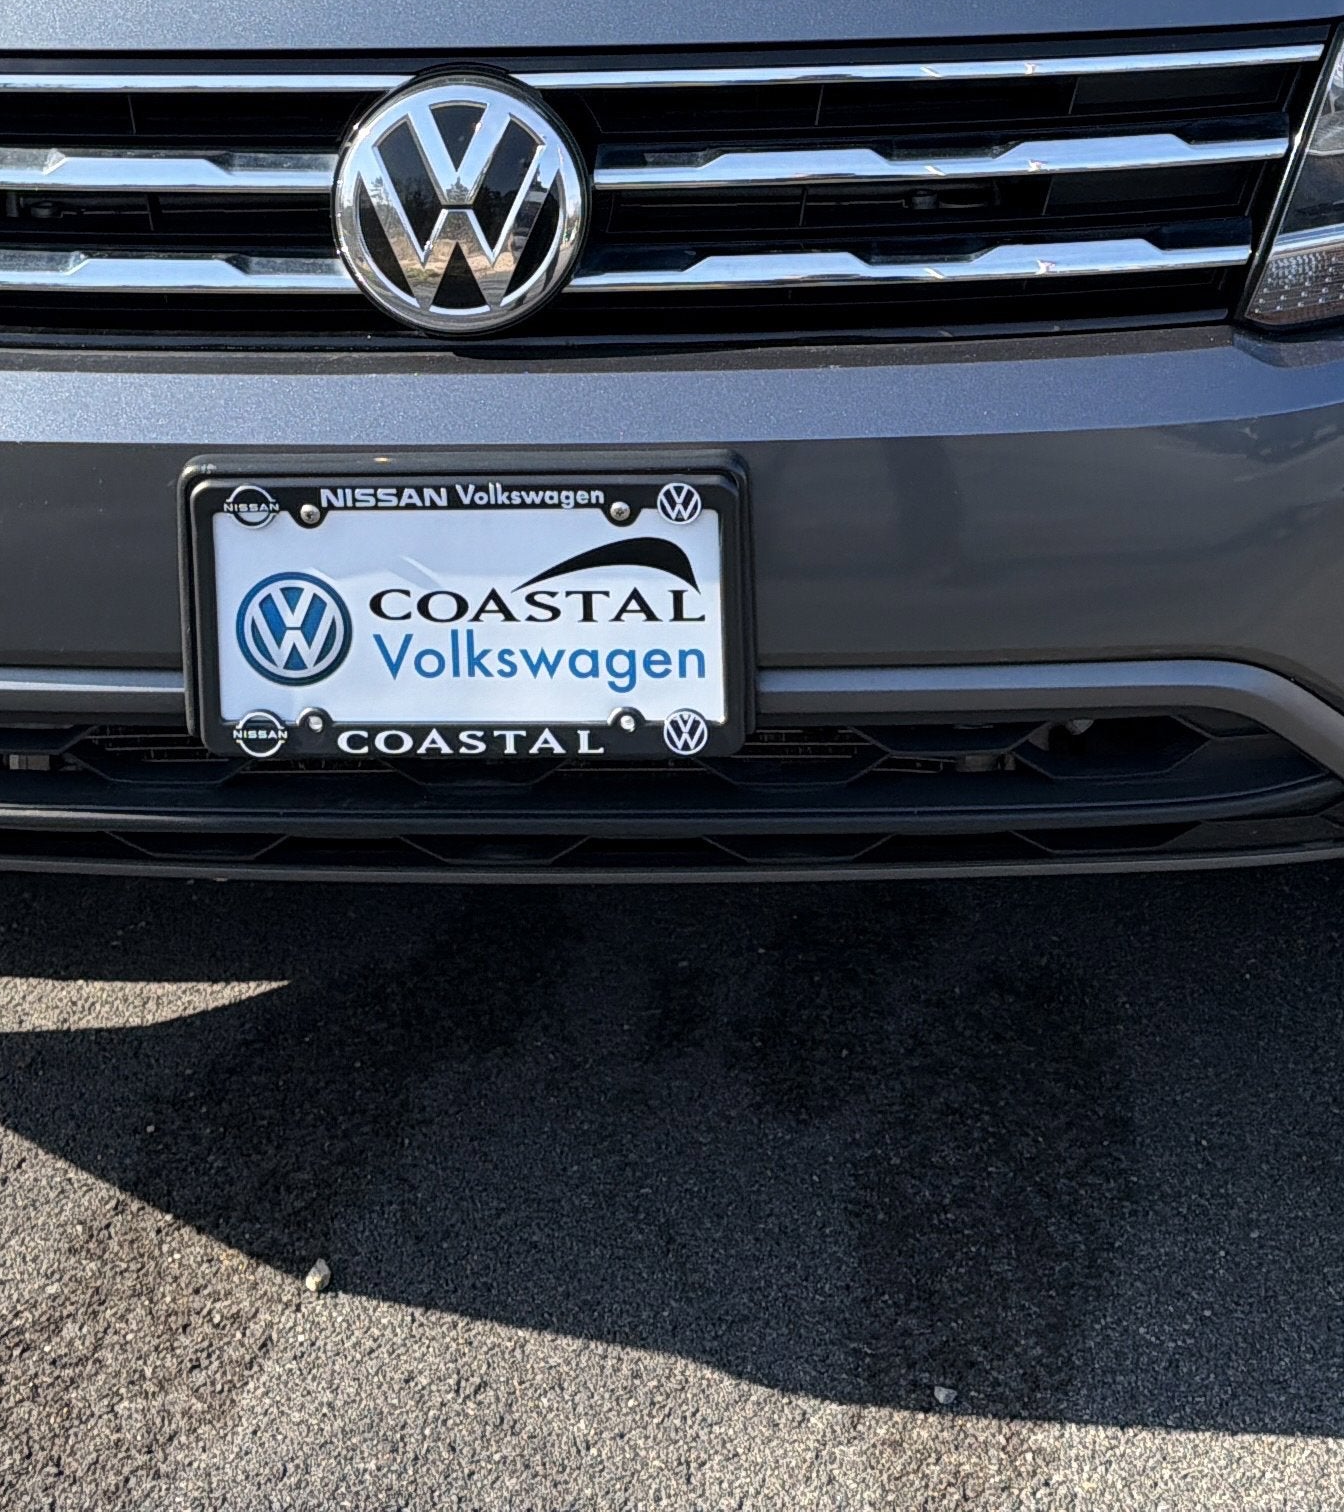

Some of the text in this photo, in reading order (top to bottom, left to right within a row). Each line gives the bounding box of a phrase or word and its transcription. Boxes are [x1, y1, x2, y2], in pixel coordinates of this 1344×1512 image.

[224, 502, 279, 512] NISSAN
[320, 482, 604, 509] NISSAN Volkswagen
[369, 587, 705, 623] COASTAL
[372, 629, 705, 693] Volkswagen
[233, 730, 288, 739] NISSAN
[337, 728, 604, 754] COASTAL
